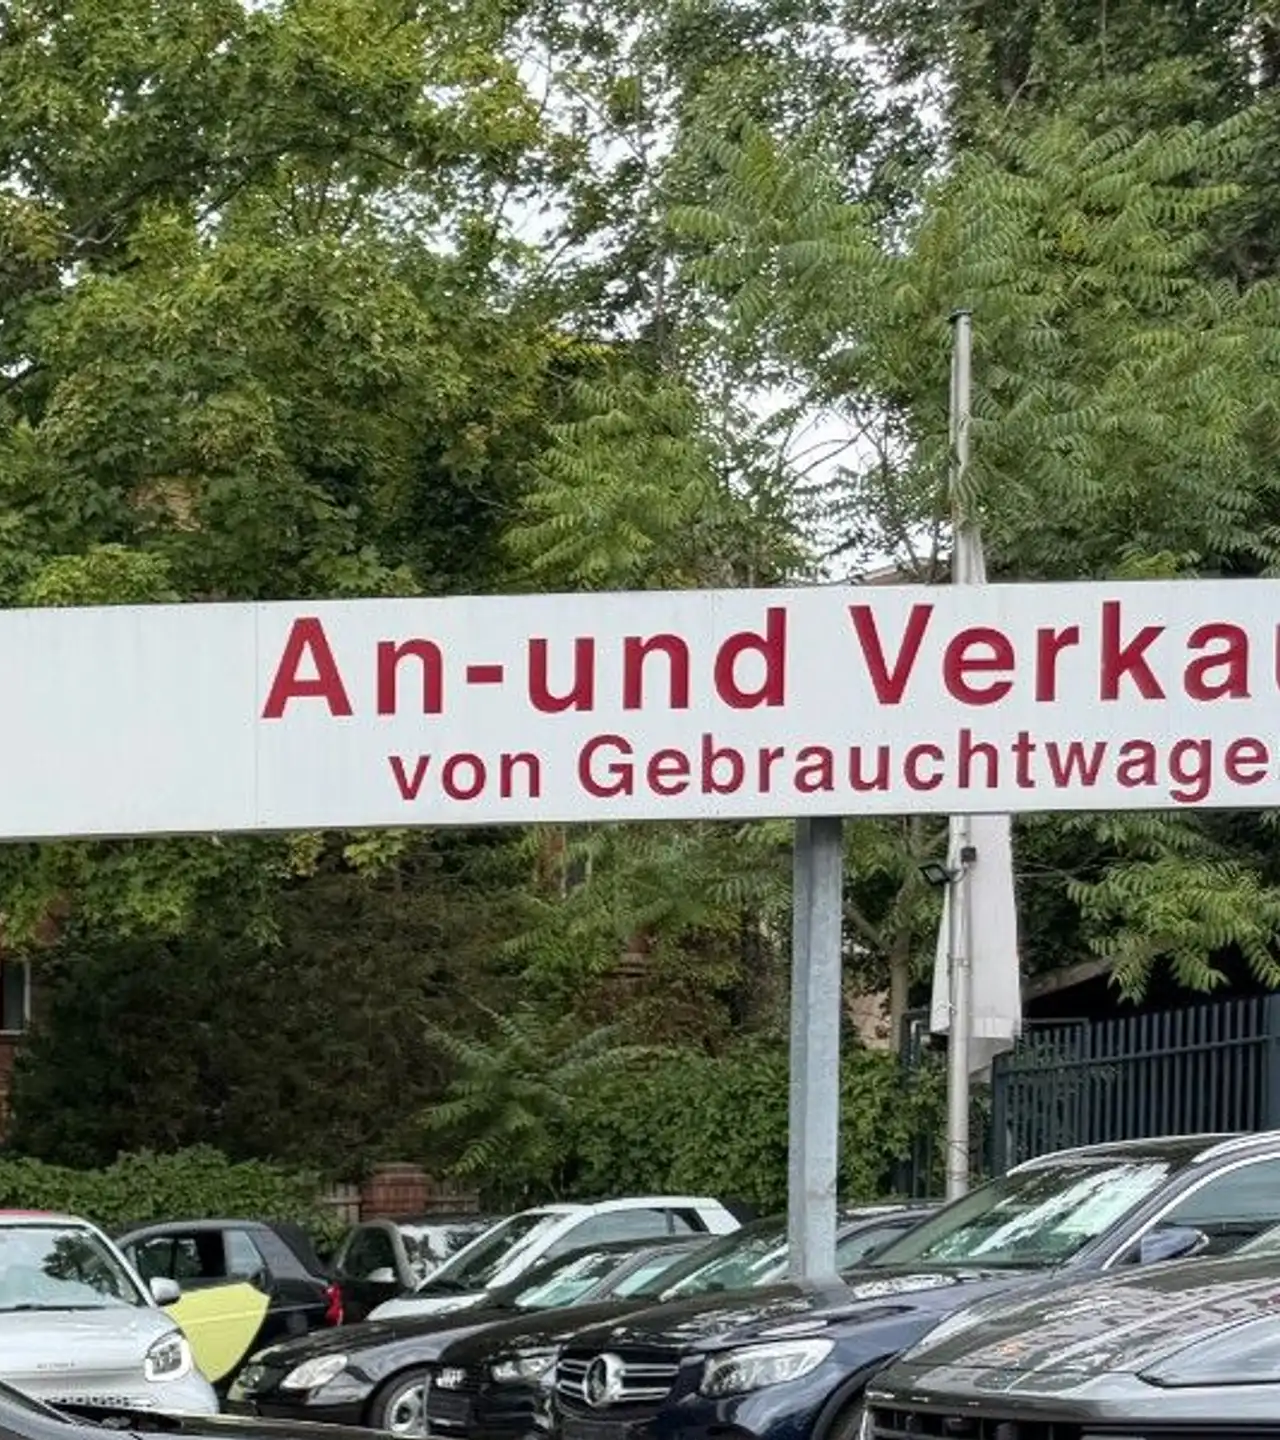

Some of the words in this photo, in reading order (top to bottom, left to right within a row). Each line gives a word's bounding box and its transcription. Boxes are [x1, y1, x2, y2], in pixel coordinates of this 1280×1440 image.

[262, 606, 787, 719] An-und
[850, 601, 1280, 704] Verka
[389, 754, 541, 801] von
